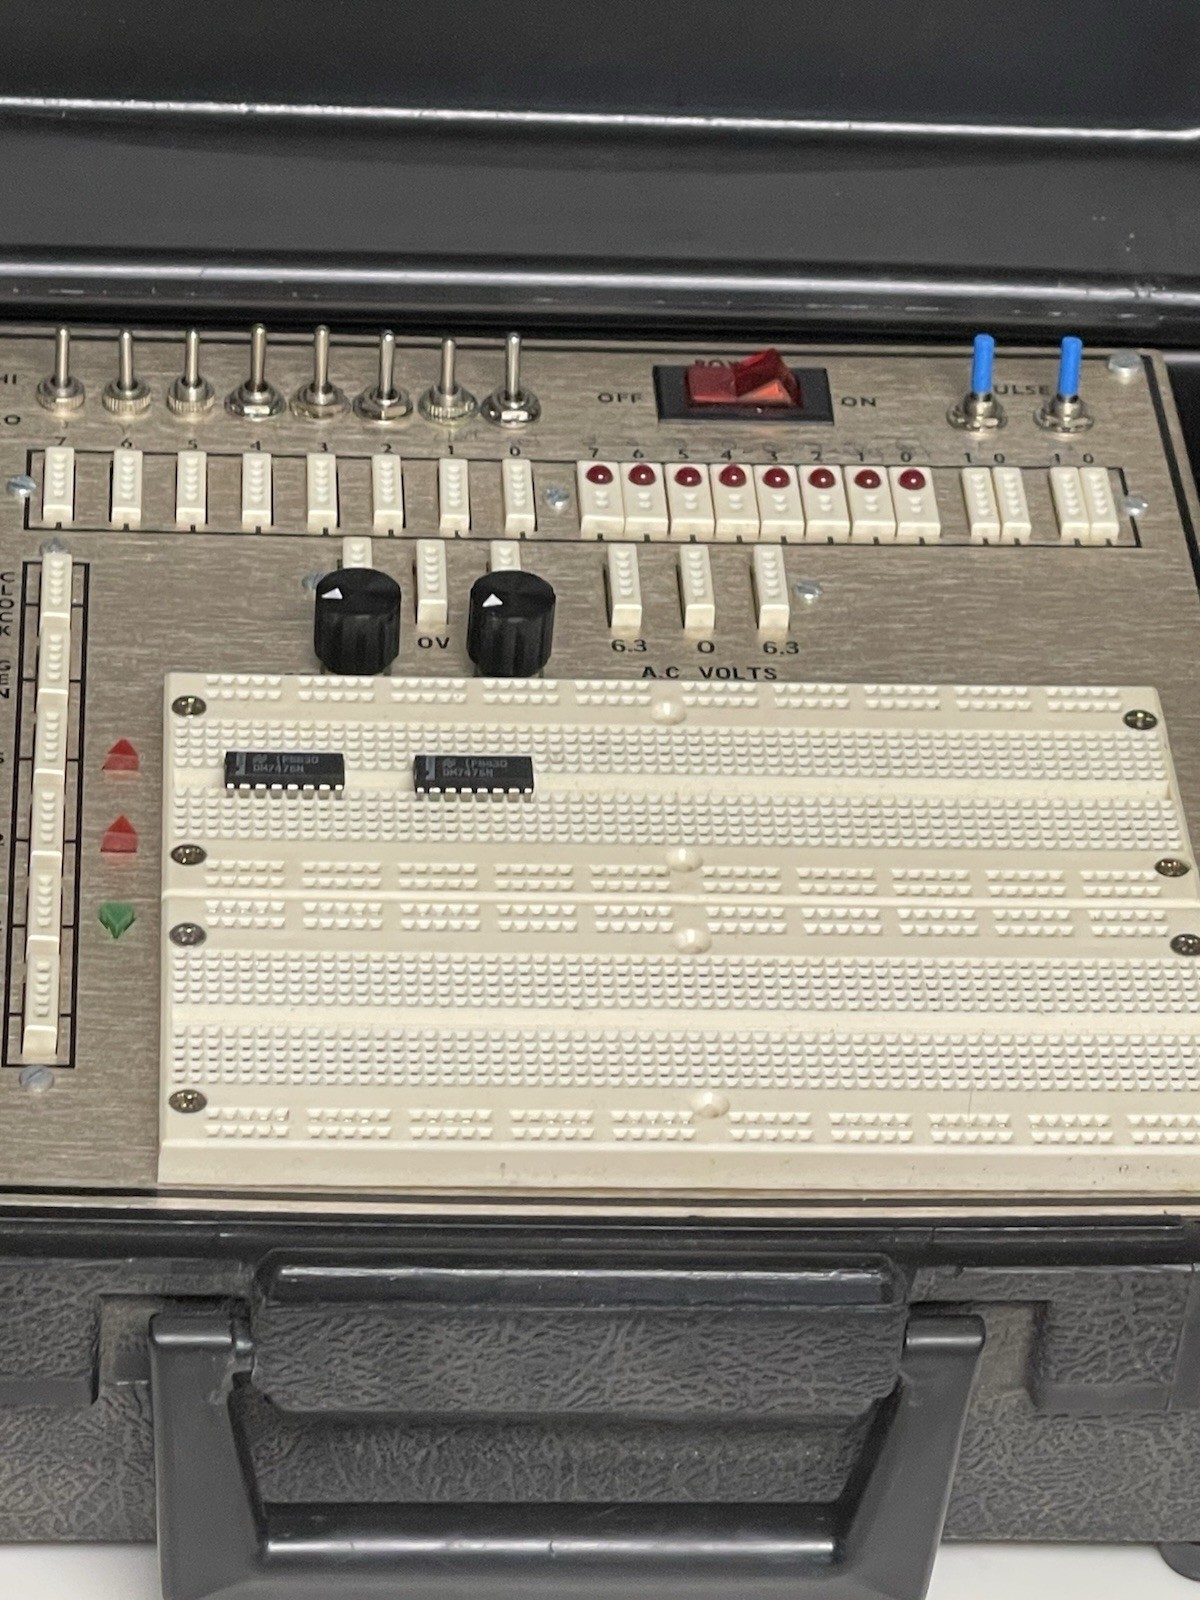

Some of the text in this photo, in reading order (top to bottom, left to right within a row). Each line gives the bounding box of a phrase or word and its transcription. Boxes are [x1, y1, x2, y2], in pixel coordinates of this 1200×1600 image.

[993, 384, 1049, 395] ULSE
[597, 393, 642, 403] OFF
[840, 396, 877, 407] ON
[56, 436, 67, 446] 7
[120, 439, 133, 449] 6
[188, 439, 198, 449] 5
[250, 440, 261, 451] 4
[319, 442, 328, 452] 3
[381, 443, 392, 453] 2
[448, 444, 454, 455] 1
[588, 447, 599, 458] 7
[632, 448, 644, 459] 6
[678, 448, 689, 459] 5
[720, 450, 732, 461] 4
[769, 451, 778, 462] 3
[811, 451, 823, 462] 2
[964, 452, 972, 463] 1
[611, 639, 648, 653] 6.3
[763, 640, 800, 655] 6.3
[641, 666, 778, 680] A.C VOLTS
